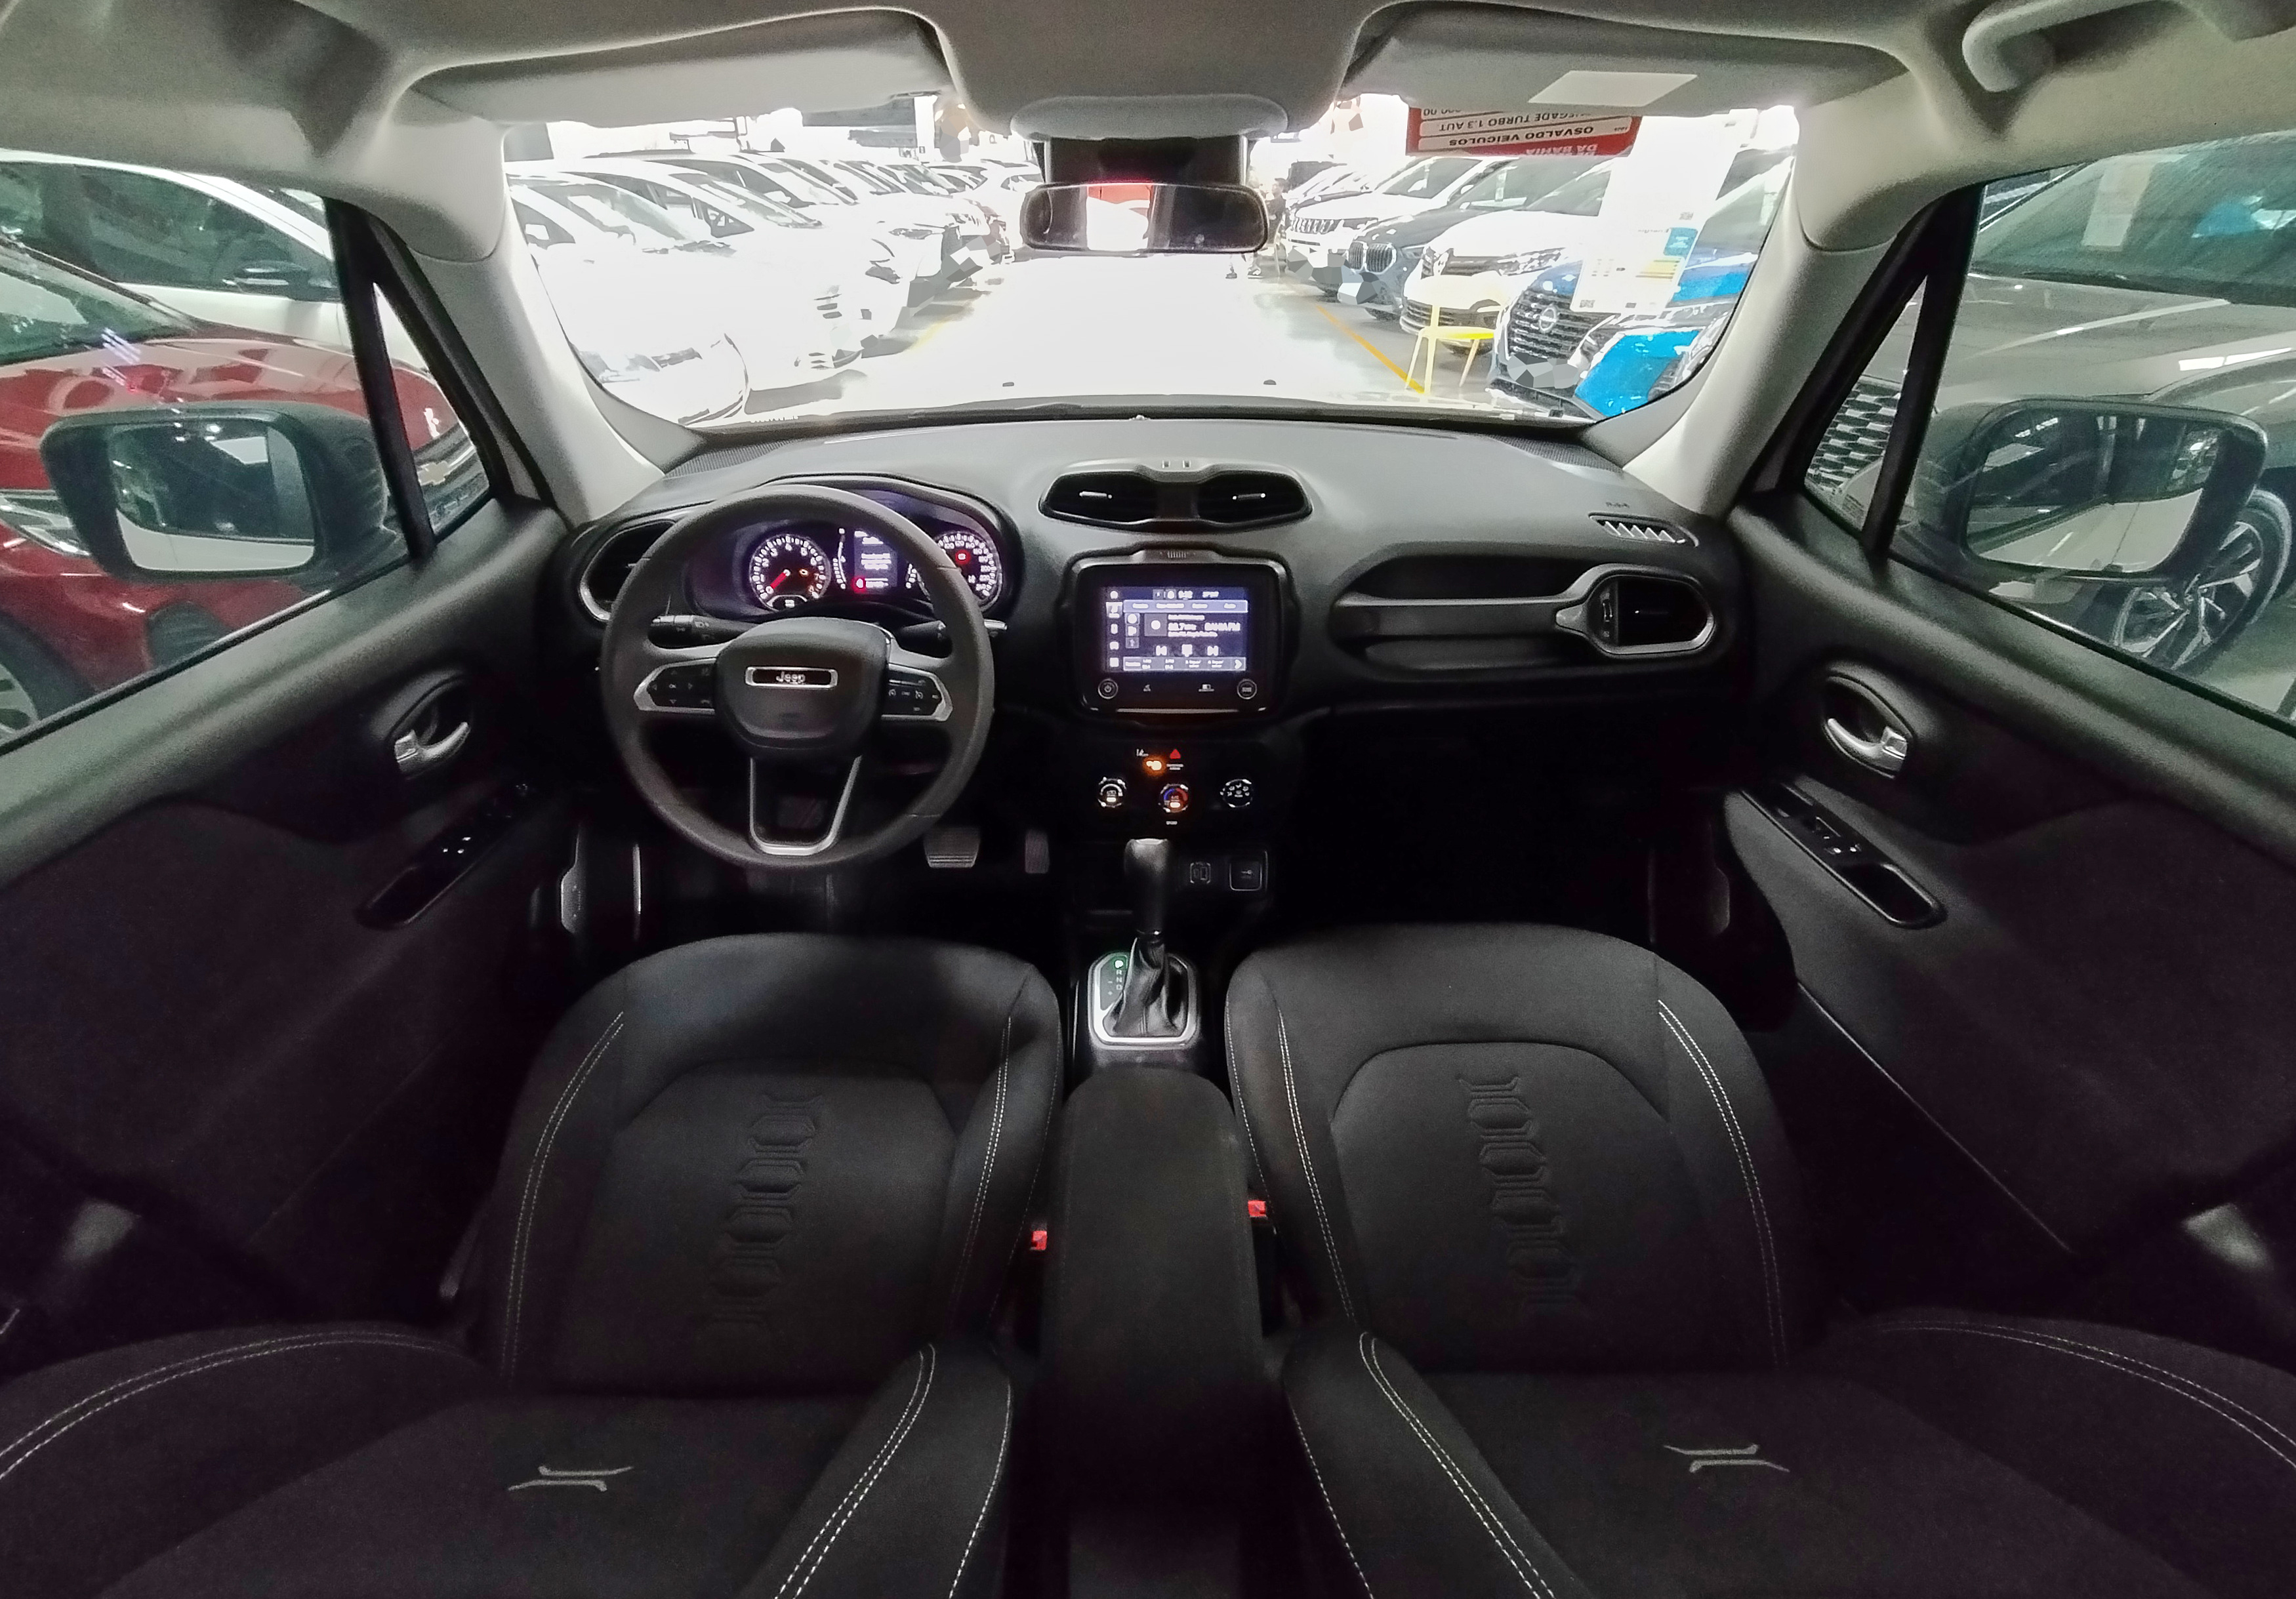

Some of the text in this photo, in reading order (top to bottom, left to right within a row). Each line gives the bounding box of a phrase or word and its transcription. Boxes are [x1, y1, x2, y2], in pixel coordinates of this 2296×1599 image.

[1439, 123, 1464, 131] AUT
[1467, 119, 1483, 128] 1.3
[1488, 114, 1529, 127] TURBO
[1449, 127, 1593, 146] OSVALDO VEICULOS
[776, 671, 806, 684] Jeep
